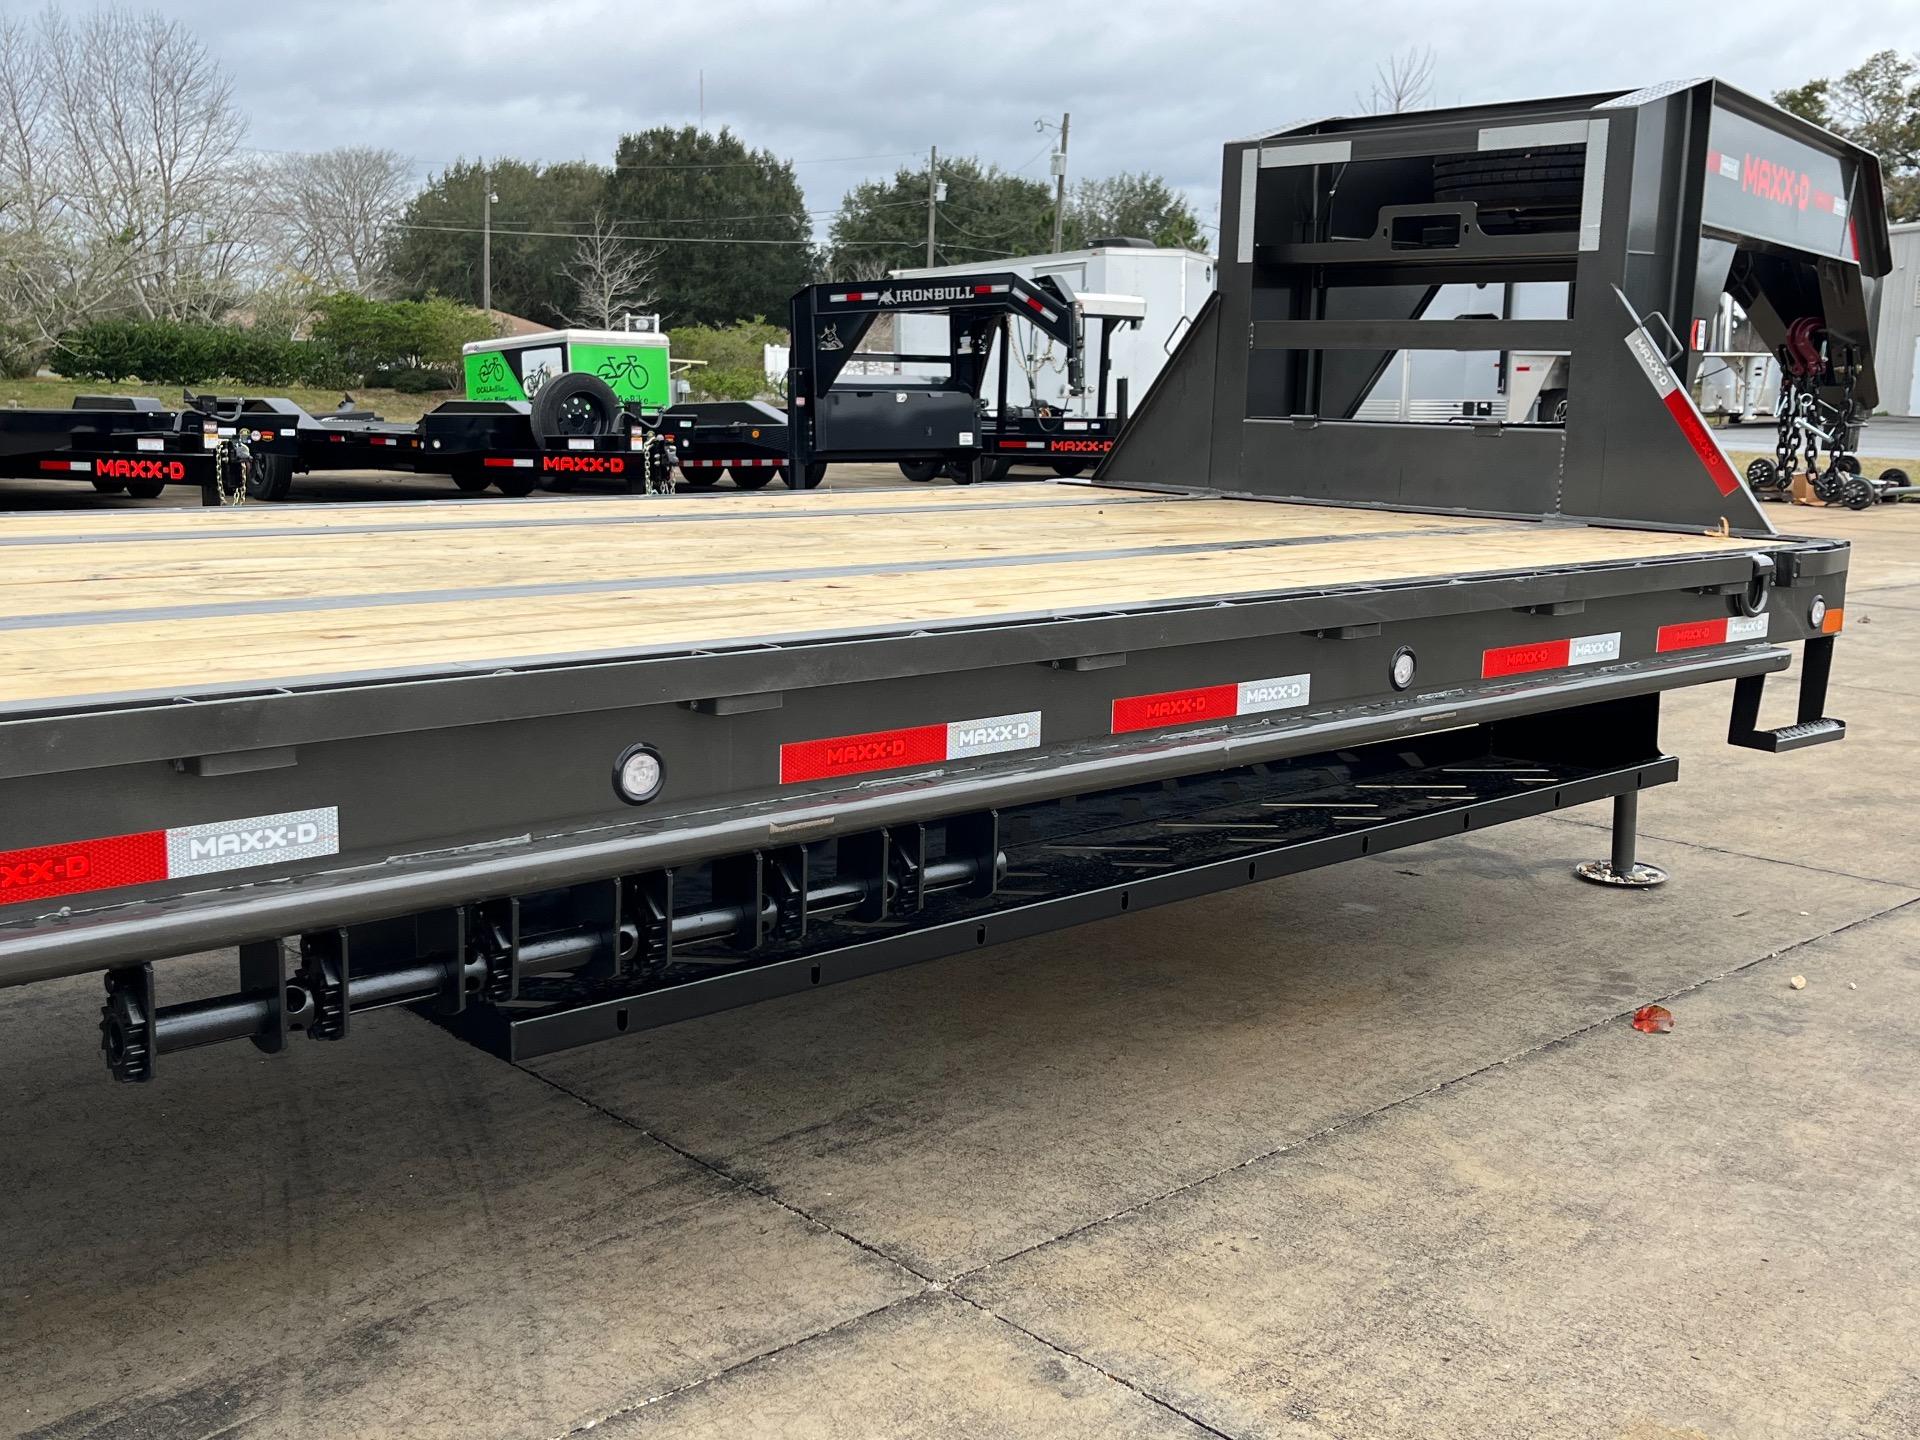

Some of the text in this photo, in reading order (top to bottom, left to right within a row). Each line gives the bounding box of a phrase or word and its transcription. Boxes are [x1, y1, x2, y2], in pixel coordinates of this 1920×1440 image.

[895, 286, 975, 302] IRONBULL
[97, 459, 185, 479] MAXX-D
[543, 456, 625, 473] MAXX-D
[1246, 684, 1300, 704] MAXX-D
[959, 723, 1029, 747] MAXX-D
[190, 822, 318, 862] MAXX-D
